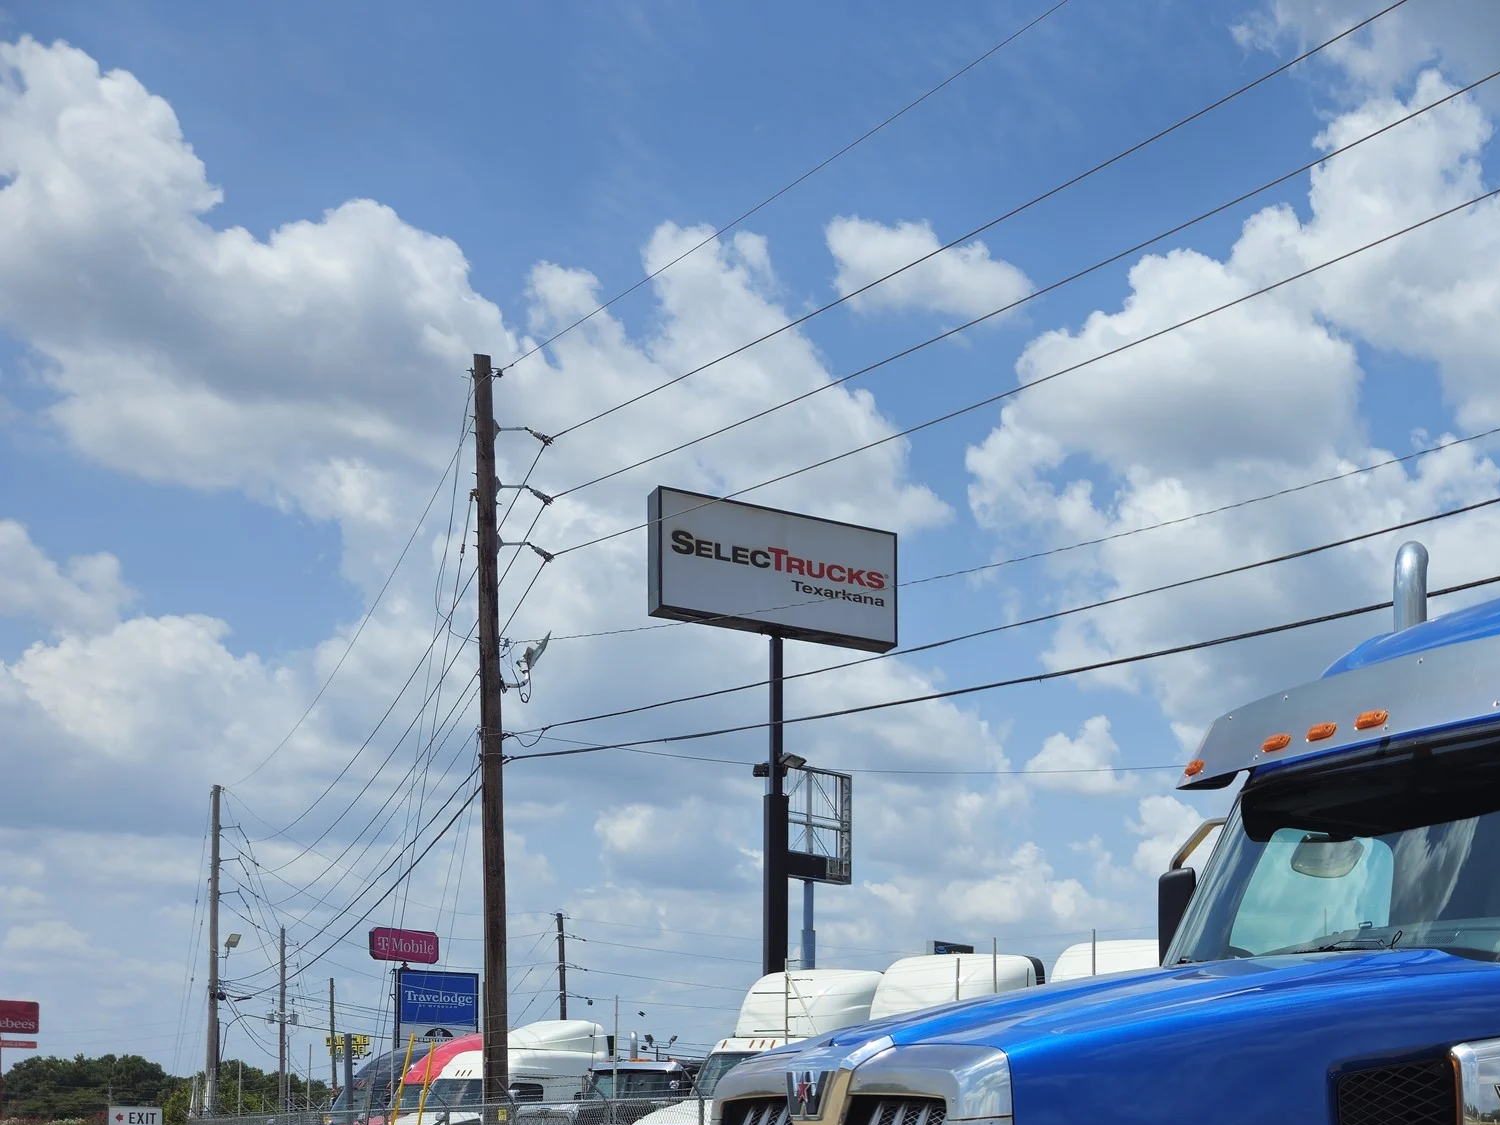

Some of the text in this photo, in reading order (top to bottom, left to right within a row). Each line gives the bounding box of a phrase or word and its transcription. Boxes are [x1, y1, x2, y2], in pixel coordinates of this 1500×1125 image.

[791, 580, 885, 607] Texarkana
[405, 990, 473, 1006] Travelodge
[129, 1112, 157, 1125] EXIT
